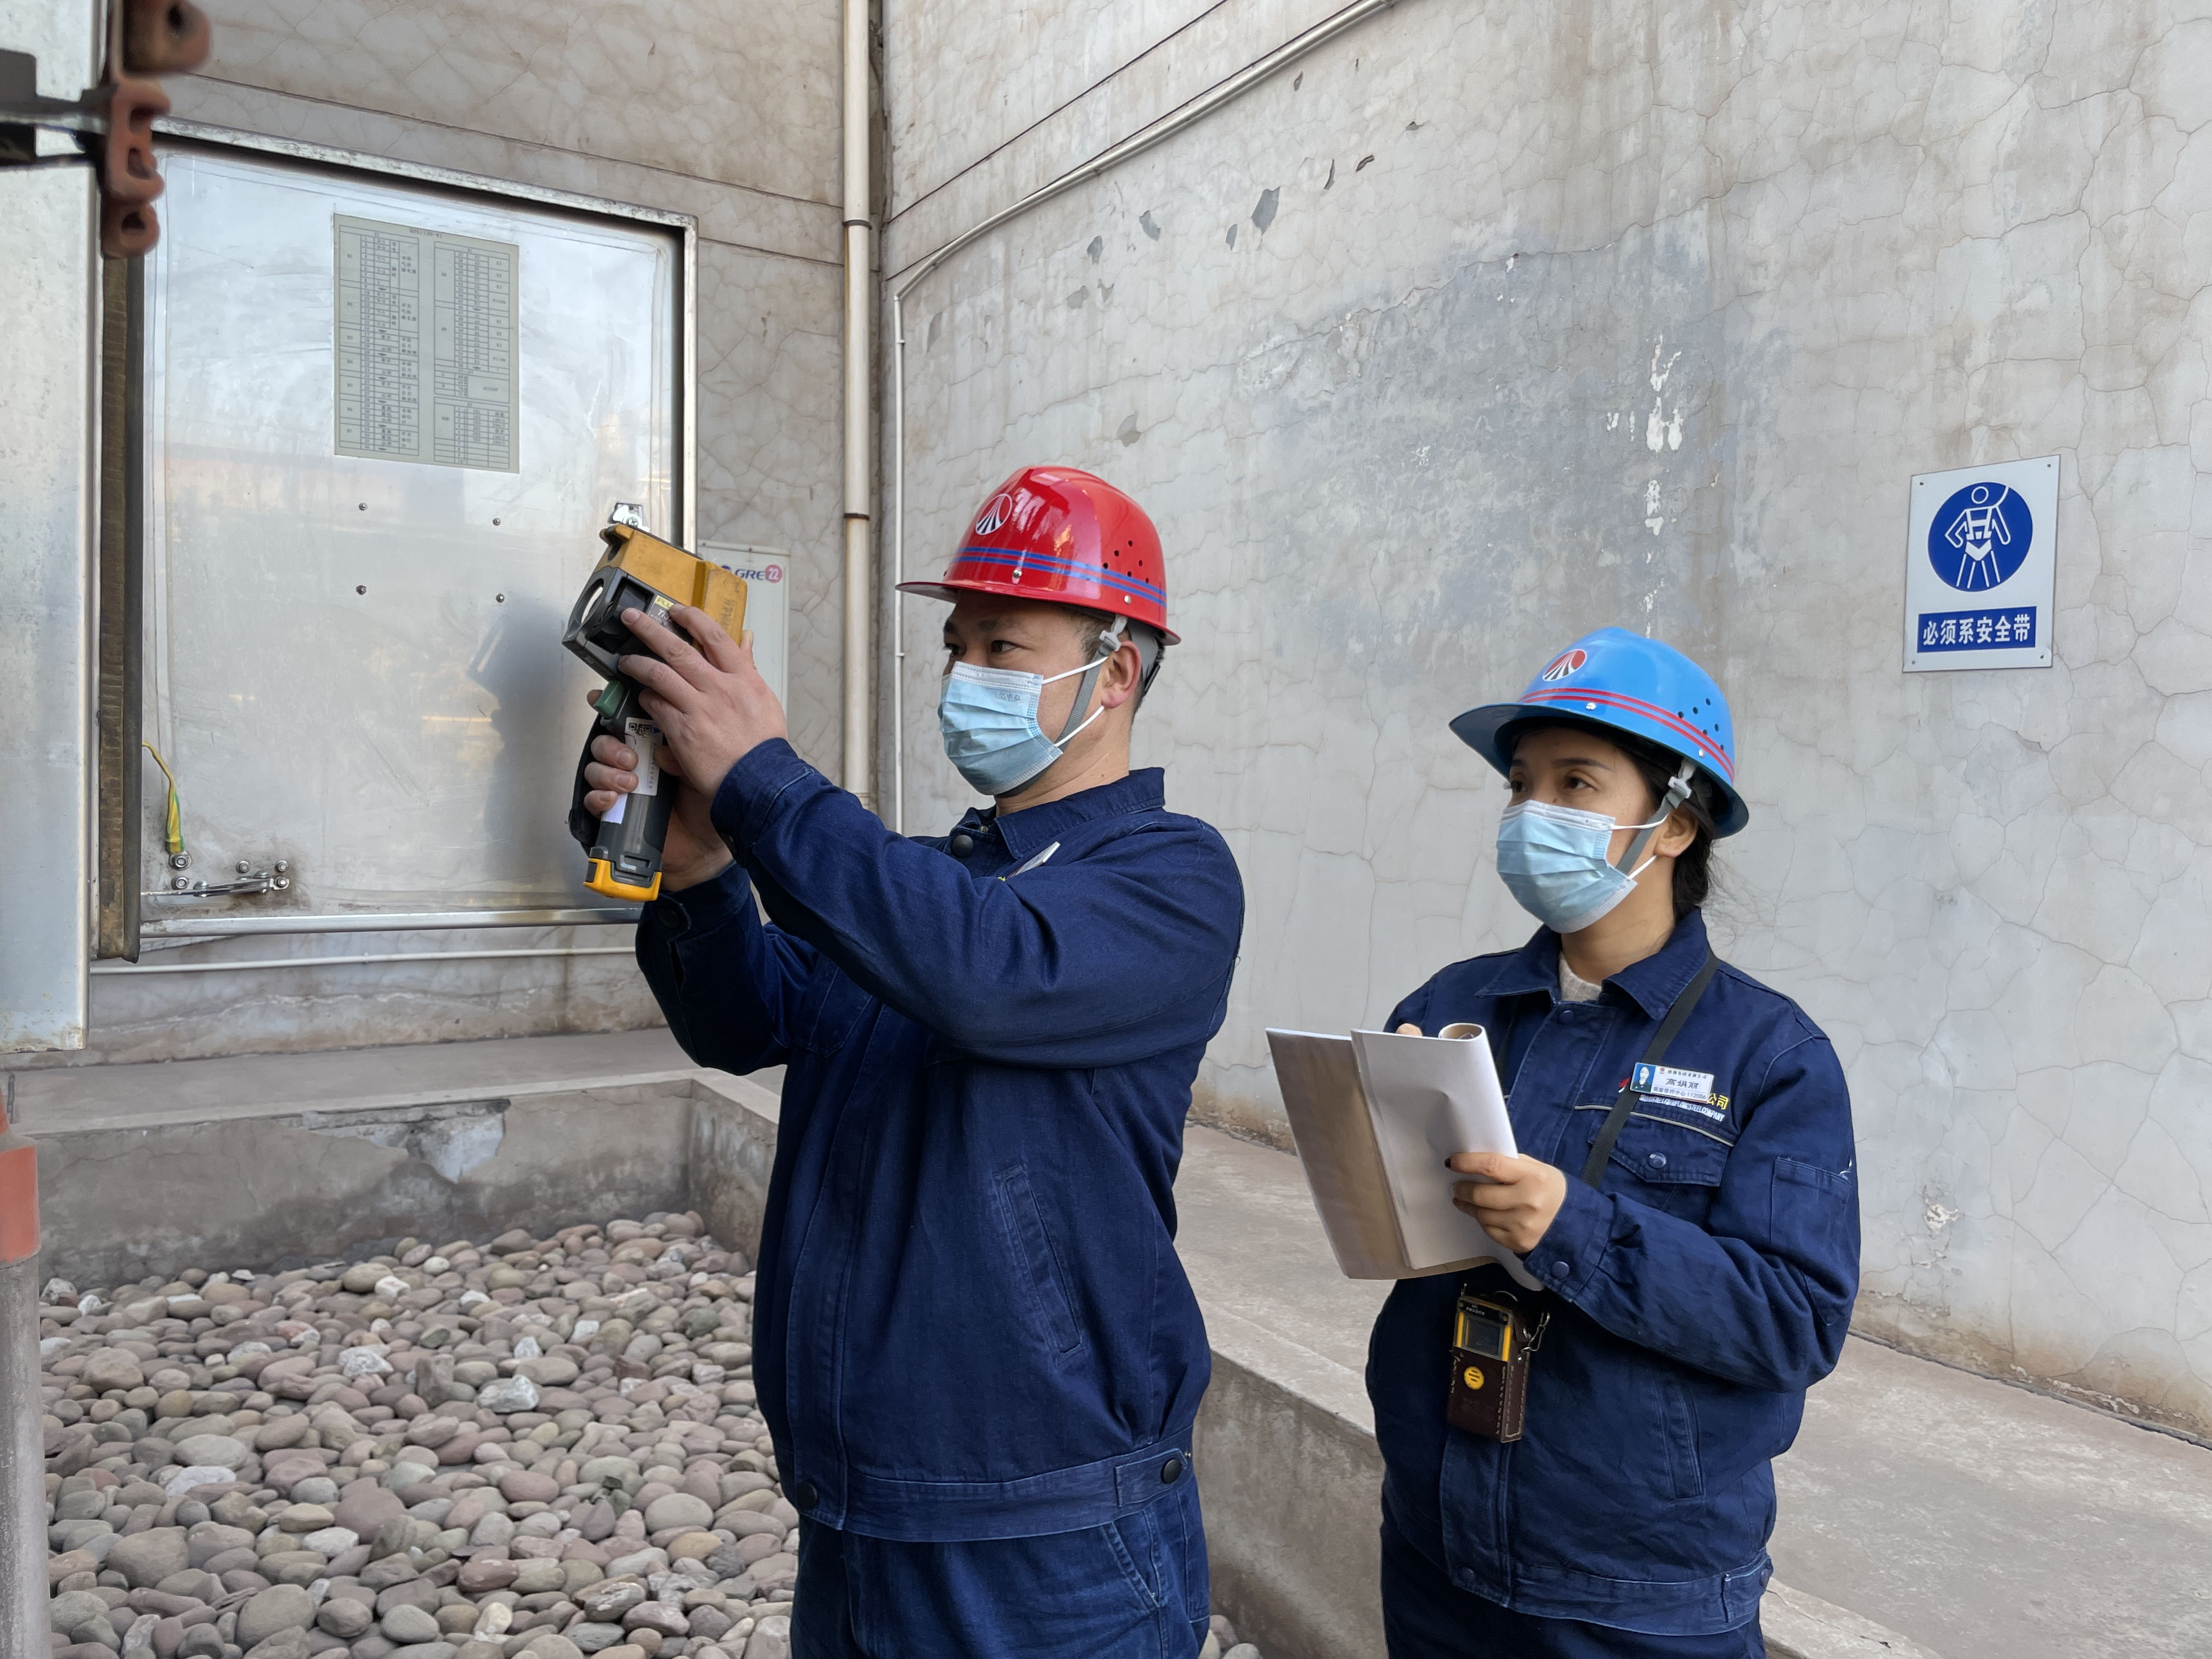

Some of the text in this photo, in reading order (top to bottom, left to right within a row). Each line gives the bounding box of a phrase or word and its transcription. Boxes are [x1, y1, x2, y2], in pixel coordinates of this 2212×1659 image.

[735, 569, 766, 580] GRE
[769, 568, 779, 580] 22
[657, 597, 670, 608] FLU
[1923, 613, 2030, 646] 必须系安全带
[1665, 1078, 1699, 1090] 高娟丽
[1708, 1092, 1729, 1110] 公司
